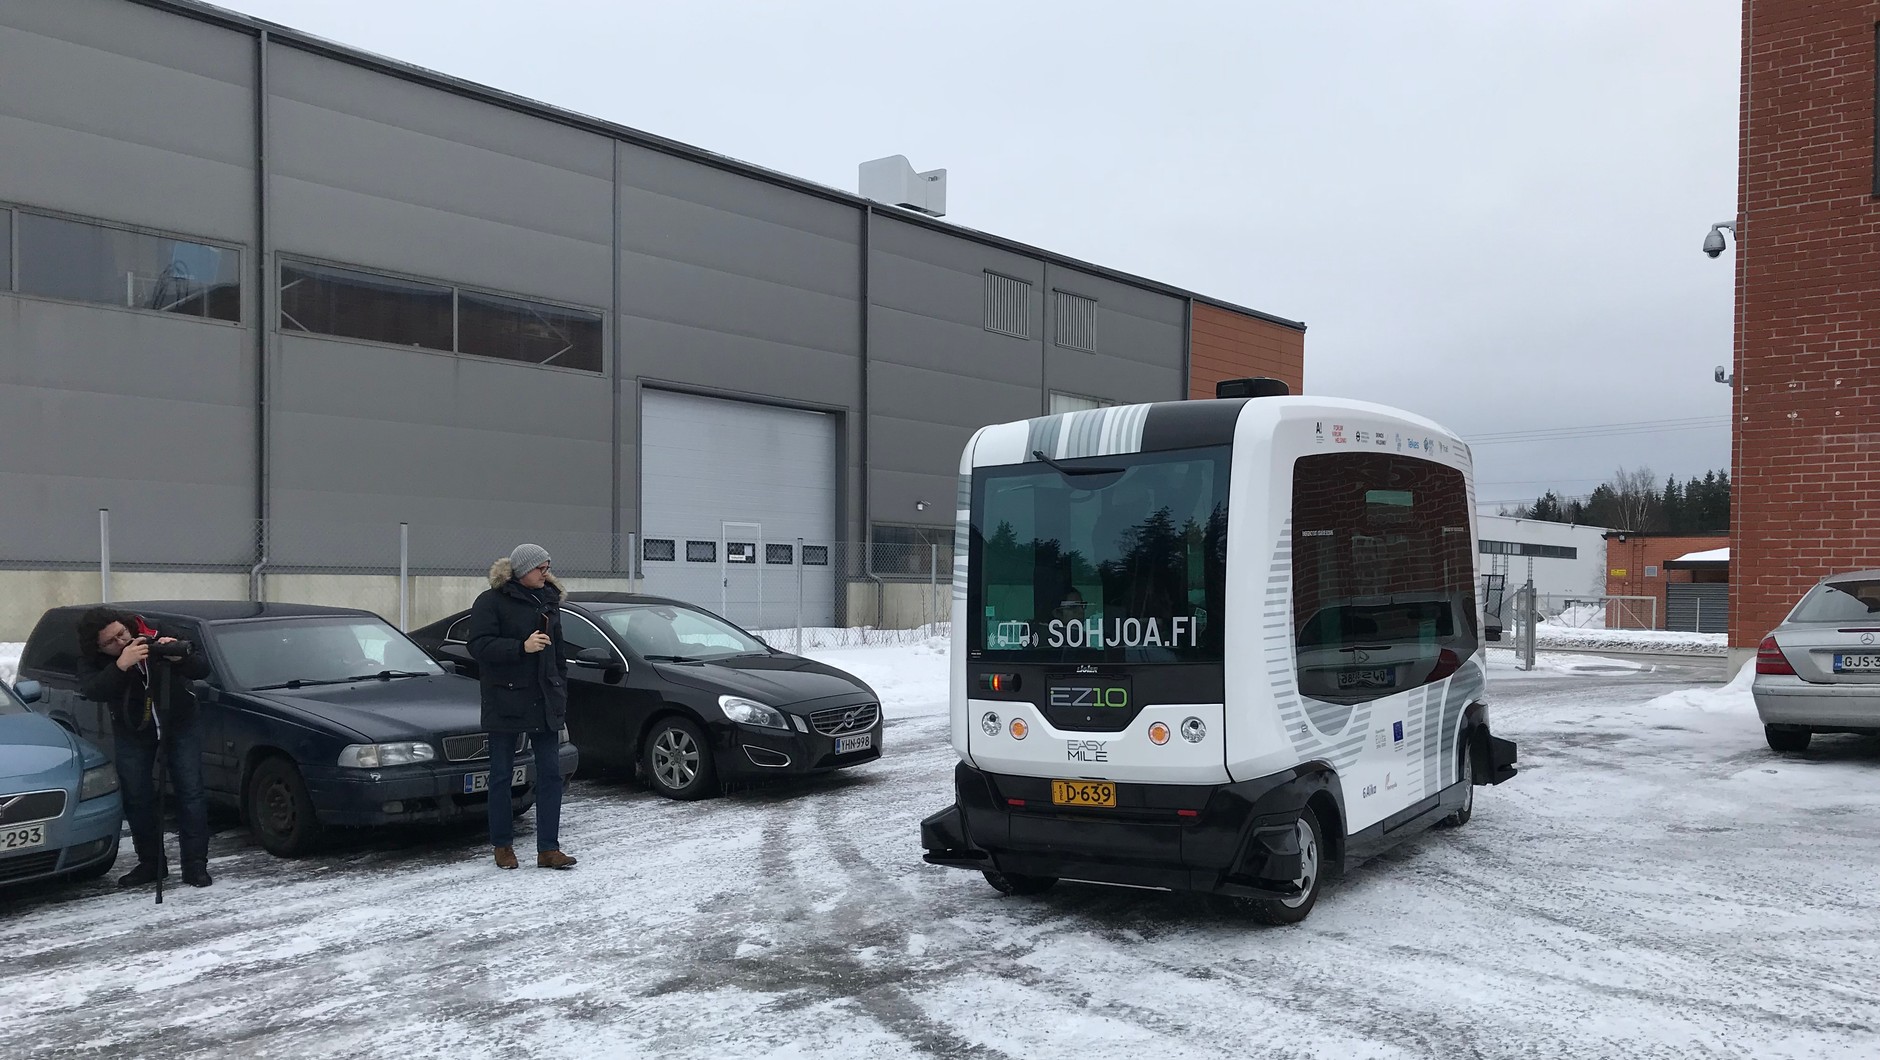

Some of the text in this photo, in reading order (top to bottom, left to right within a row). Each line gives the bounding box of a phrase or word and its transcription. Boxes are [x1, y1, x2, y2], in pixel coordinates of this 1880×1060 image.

[1047, 616, 1197, 648] SOHJOA.FI
[1844, 656, 1880, 667] GJS-3
[1050, 687, 1128, 708] EZ10
[841, 735, 870, 750] YHN-998
[1067, 740, 1107, 750] EASY
[1067, 751, 1108, 762] MILE
